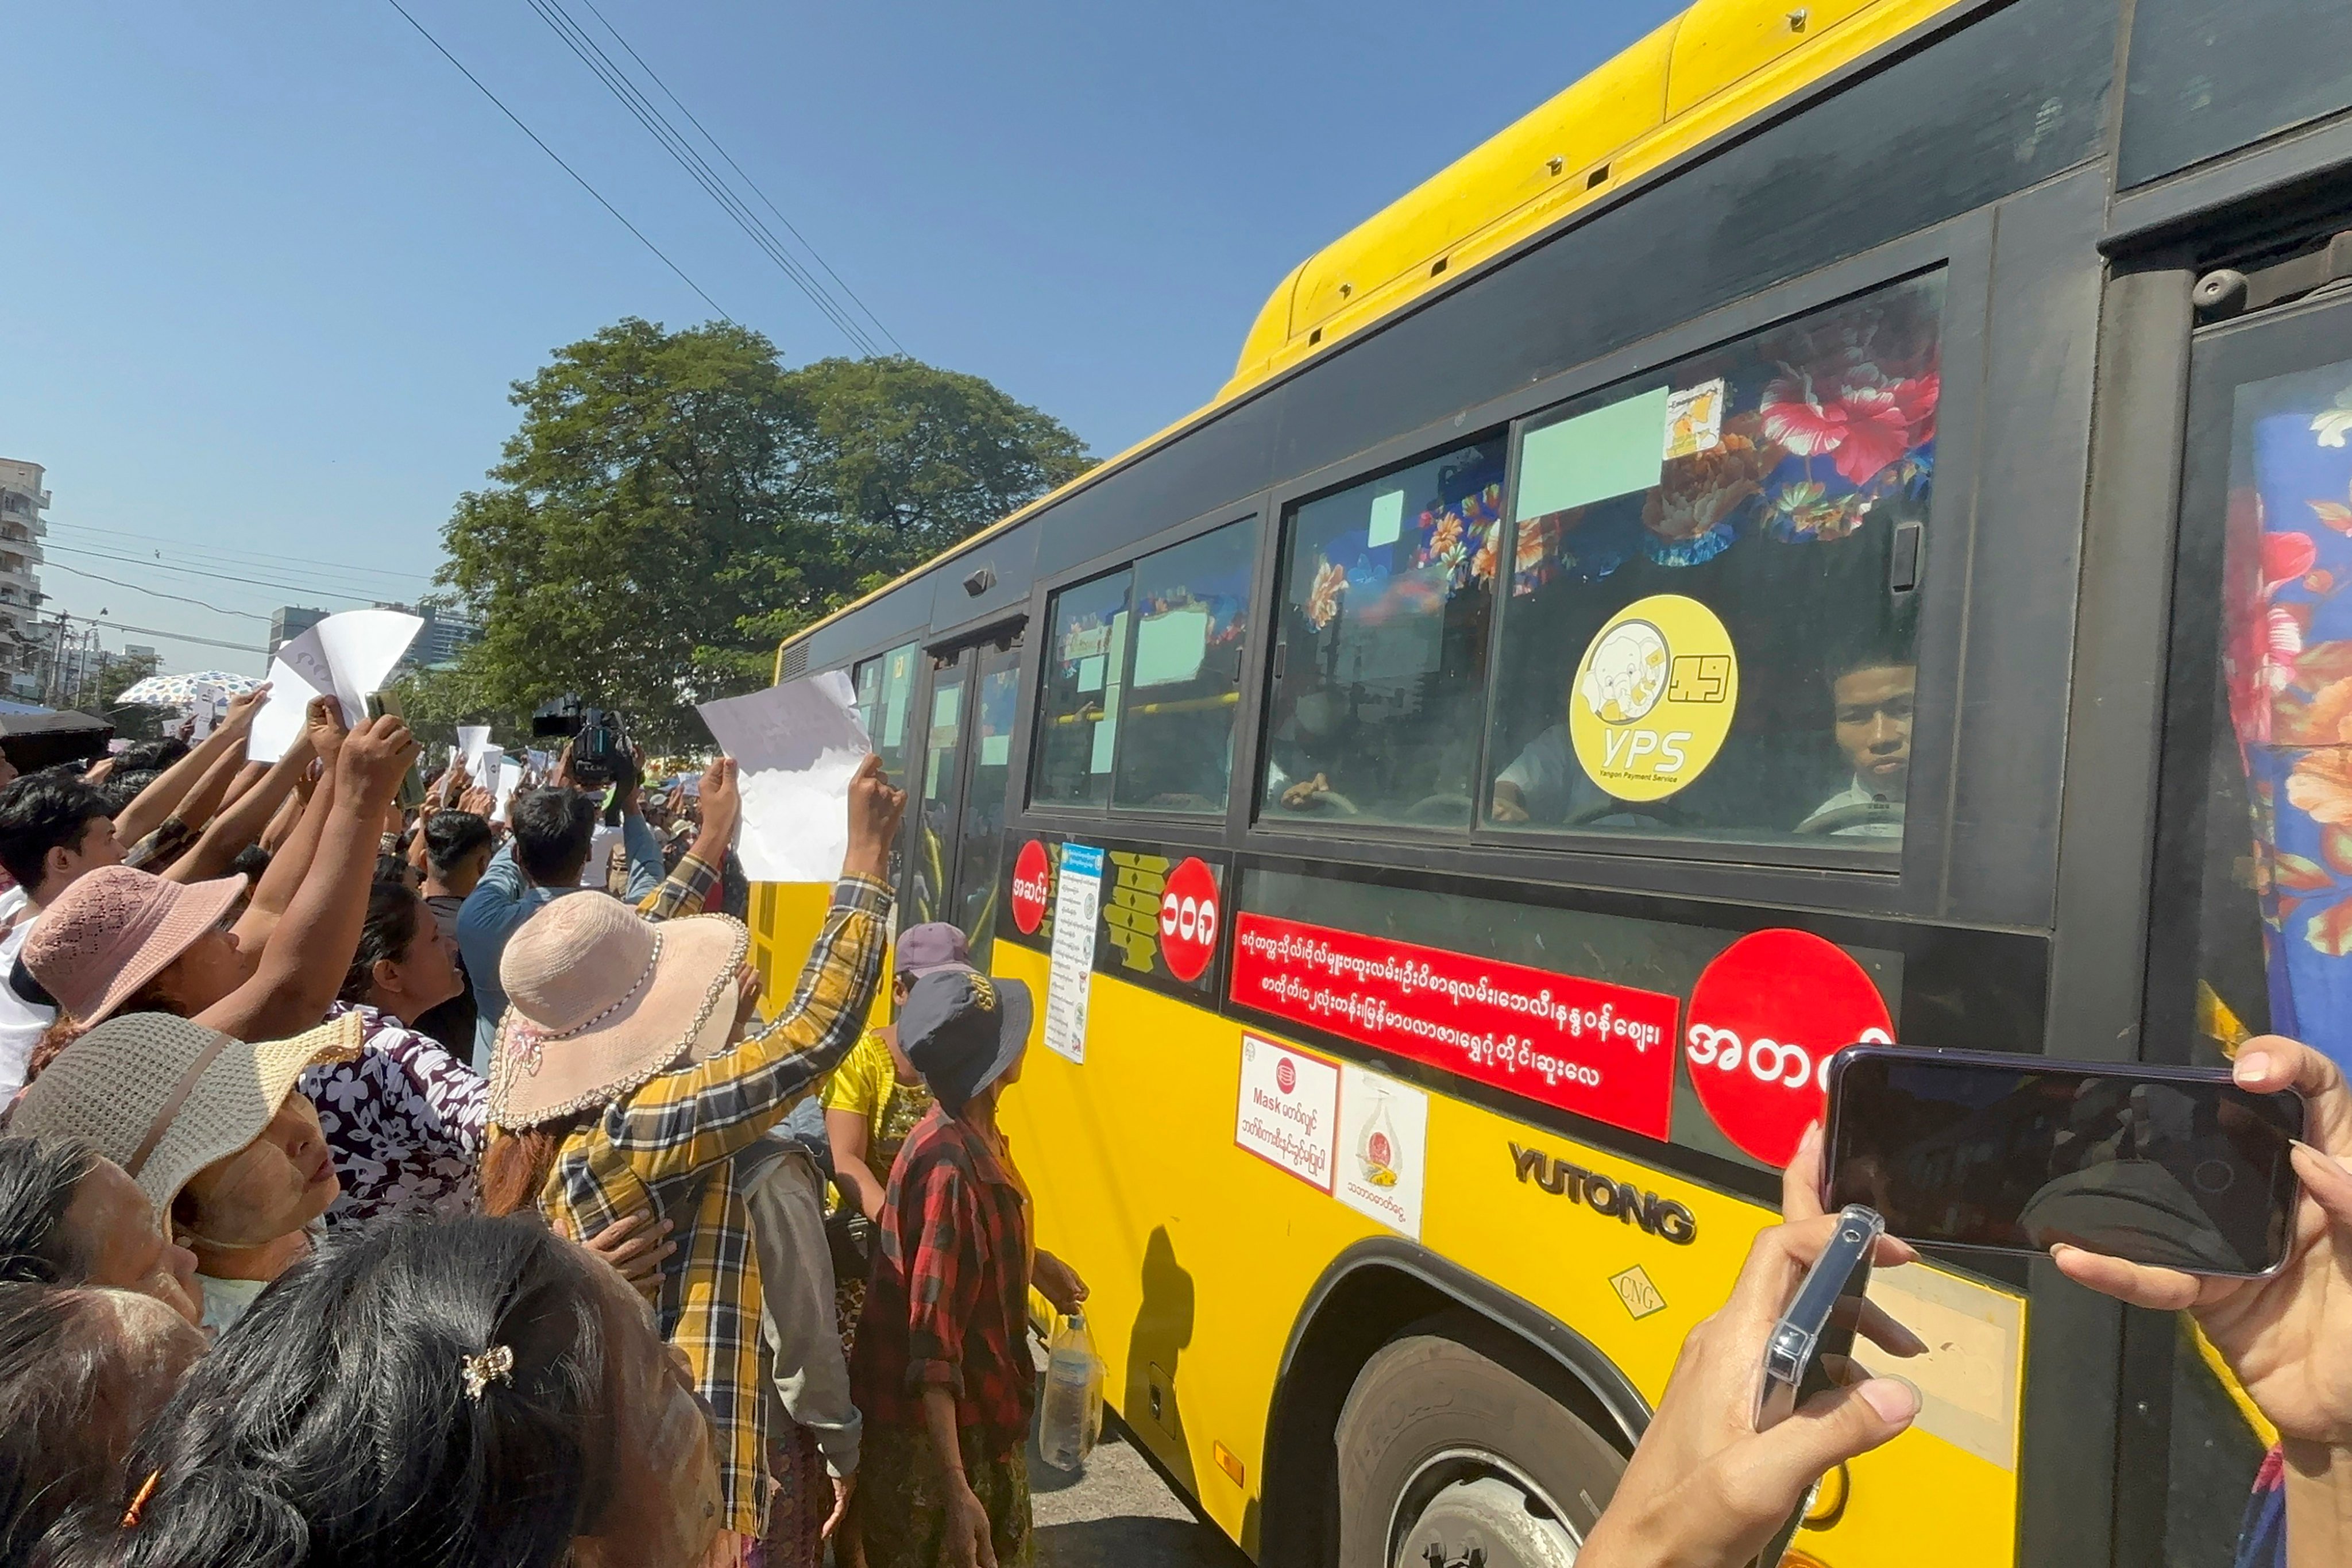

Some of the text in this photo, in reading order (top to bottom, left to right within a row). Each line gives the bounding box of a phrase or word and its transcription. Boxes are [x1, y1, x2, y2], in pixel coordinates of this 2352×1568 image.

[1602, 729, 1693, 773] YPS
[1600, 770, 1678, 783] Yangon Payment Service
[1014, 872, 1046, 906] အဆင်း
[1253, 1087, 1281, 1114] Mask
[1508, 1141, 1697, 1245] YUTONG
[1619, 1276, 1654, 1310] CNG
